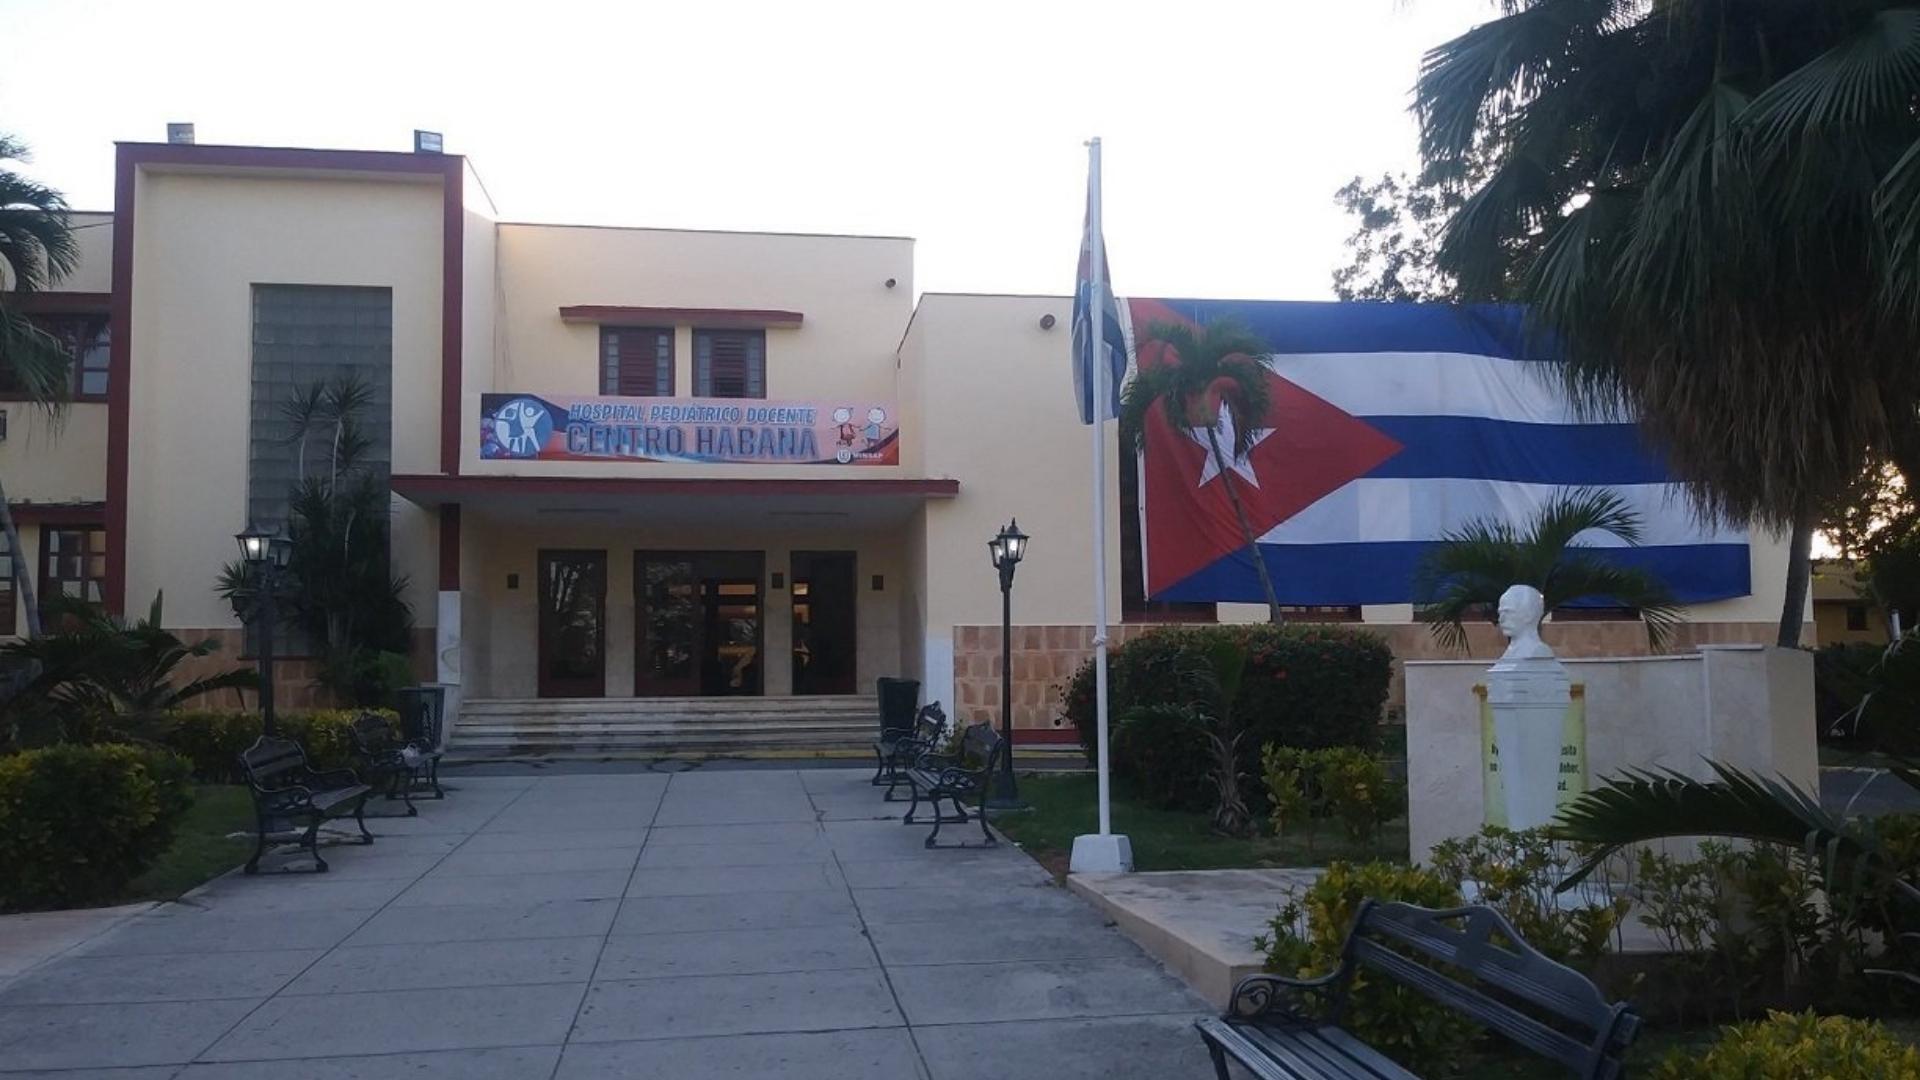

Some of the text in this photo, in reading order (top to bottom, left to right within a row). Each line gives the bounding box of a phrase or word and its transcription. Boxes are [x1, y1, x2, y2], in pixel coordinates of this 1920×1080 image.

[569, 402, 818, 425] HOSPITAL PEDIÁTRICO DOCENTE
[566, 424, 818, 459] CENTRO HABANA
